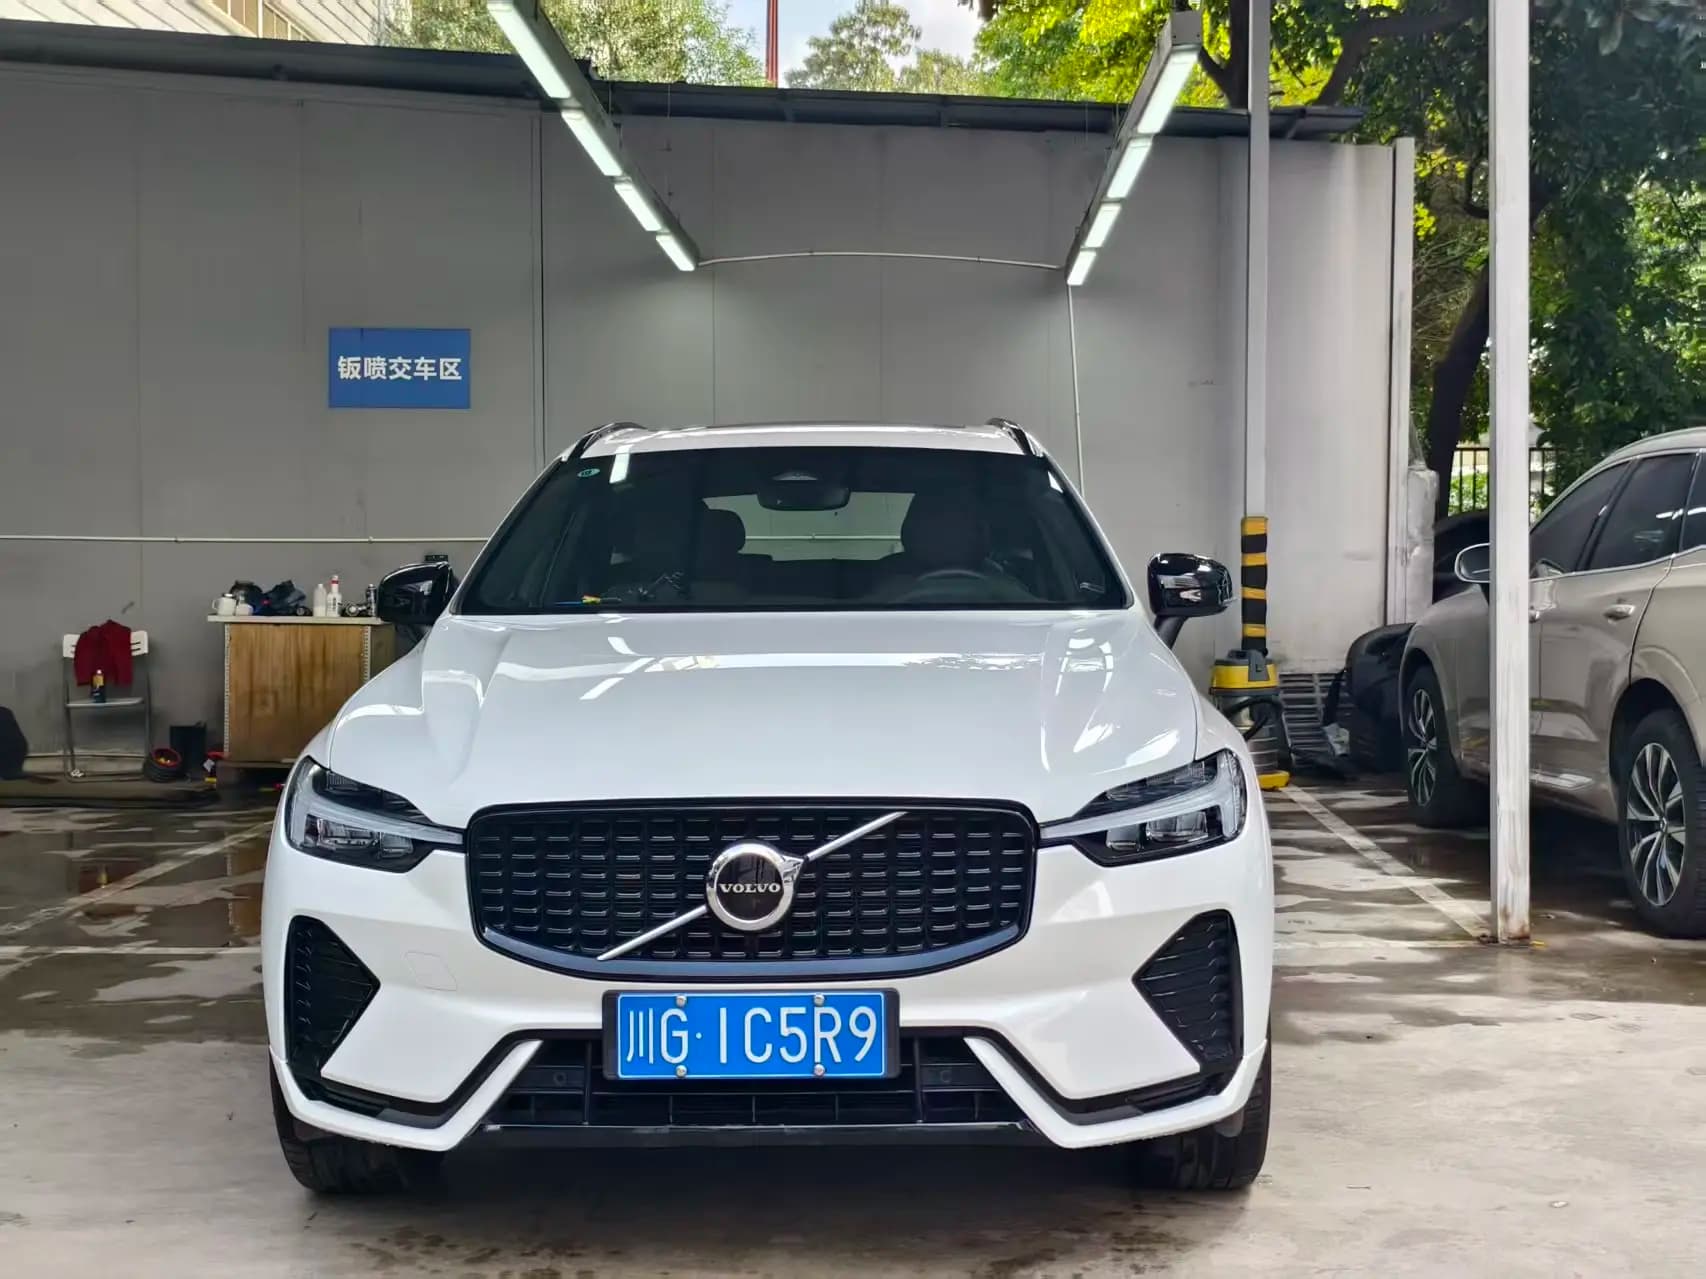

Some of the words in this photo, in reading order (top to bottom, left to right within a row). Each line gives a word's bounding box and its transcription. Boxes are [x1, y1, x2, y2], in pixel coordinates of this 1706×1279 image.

[338, 356, 462, 381] 钣喷交车区
[719, 883, 780, 893] VOLVO
